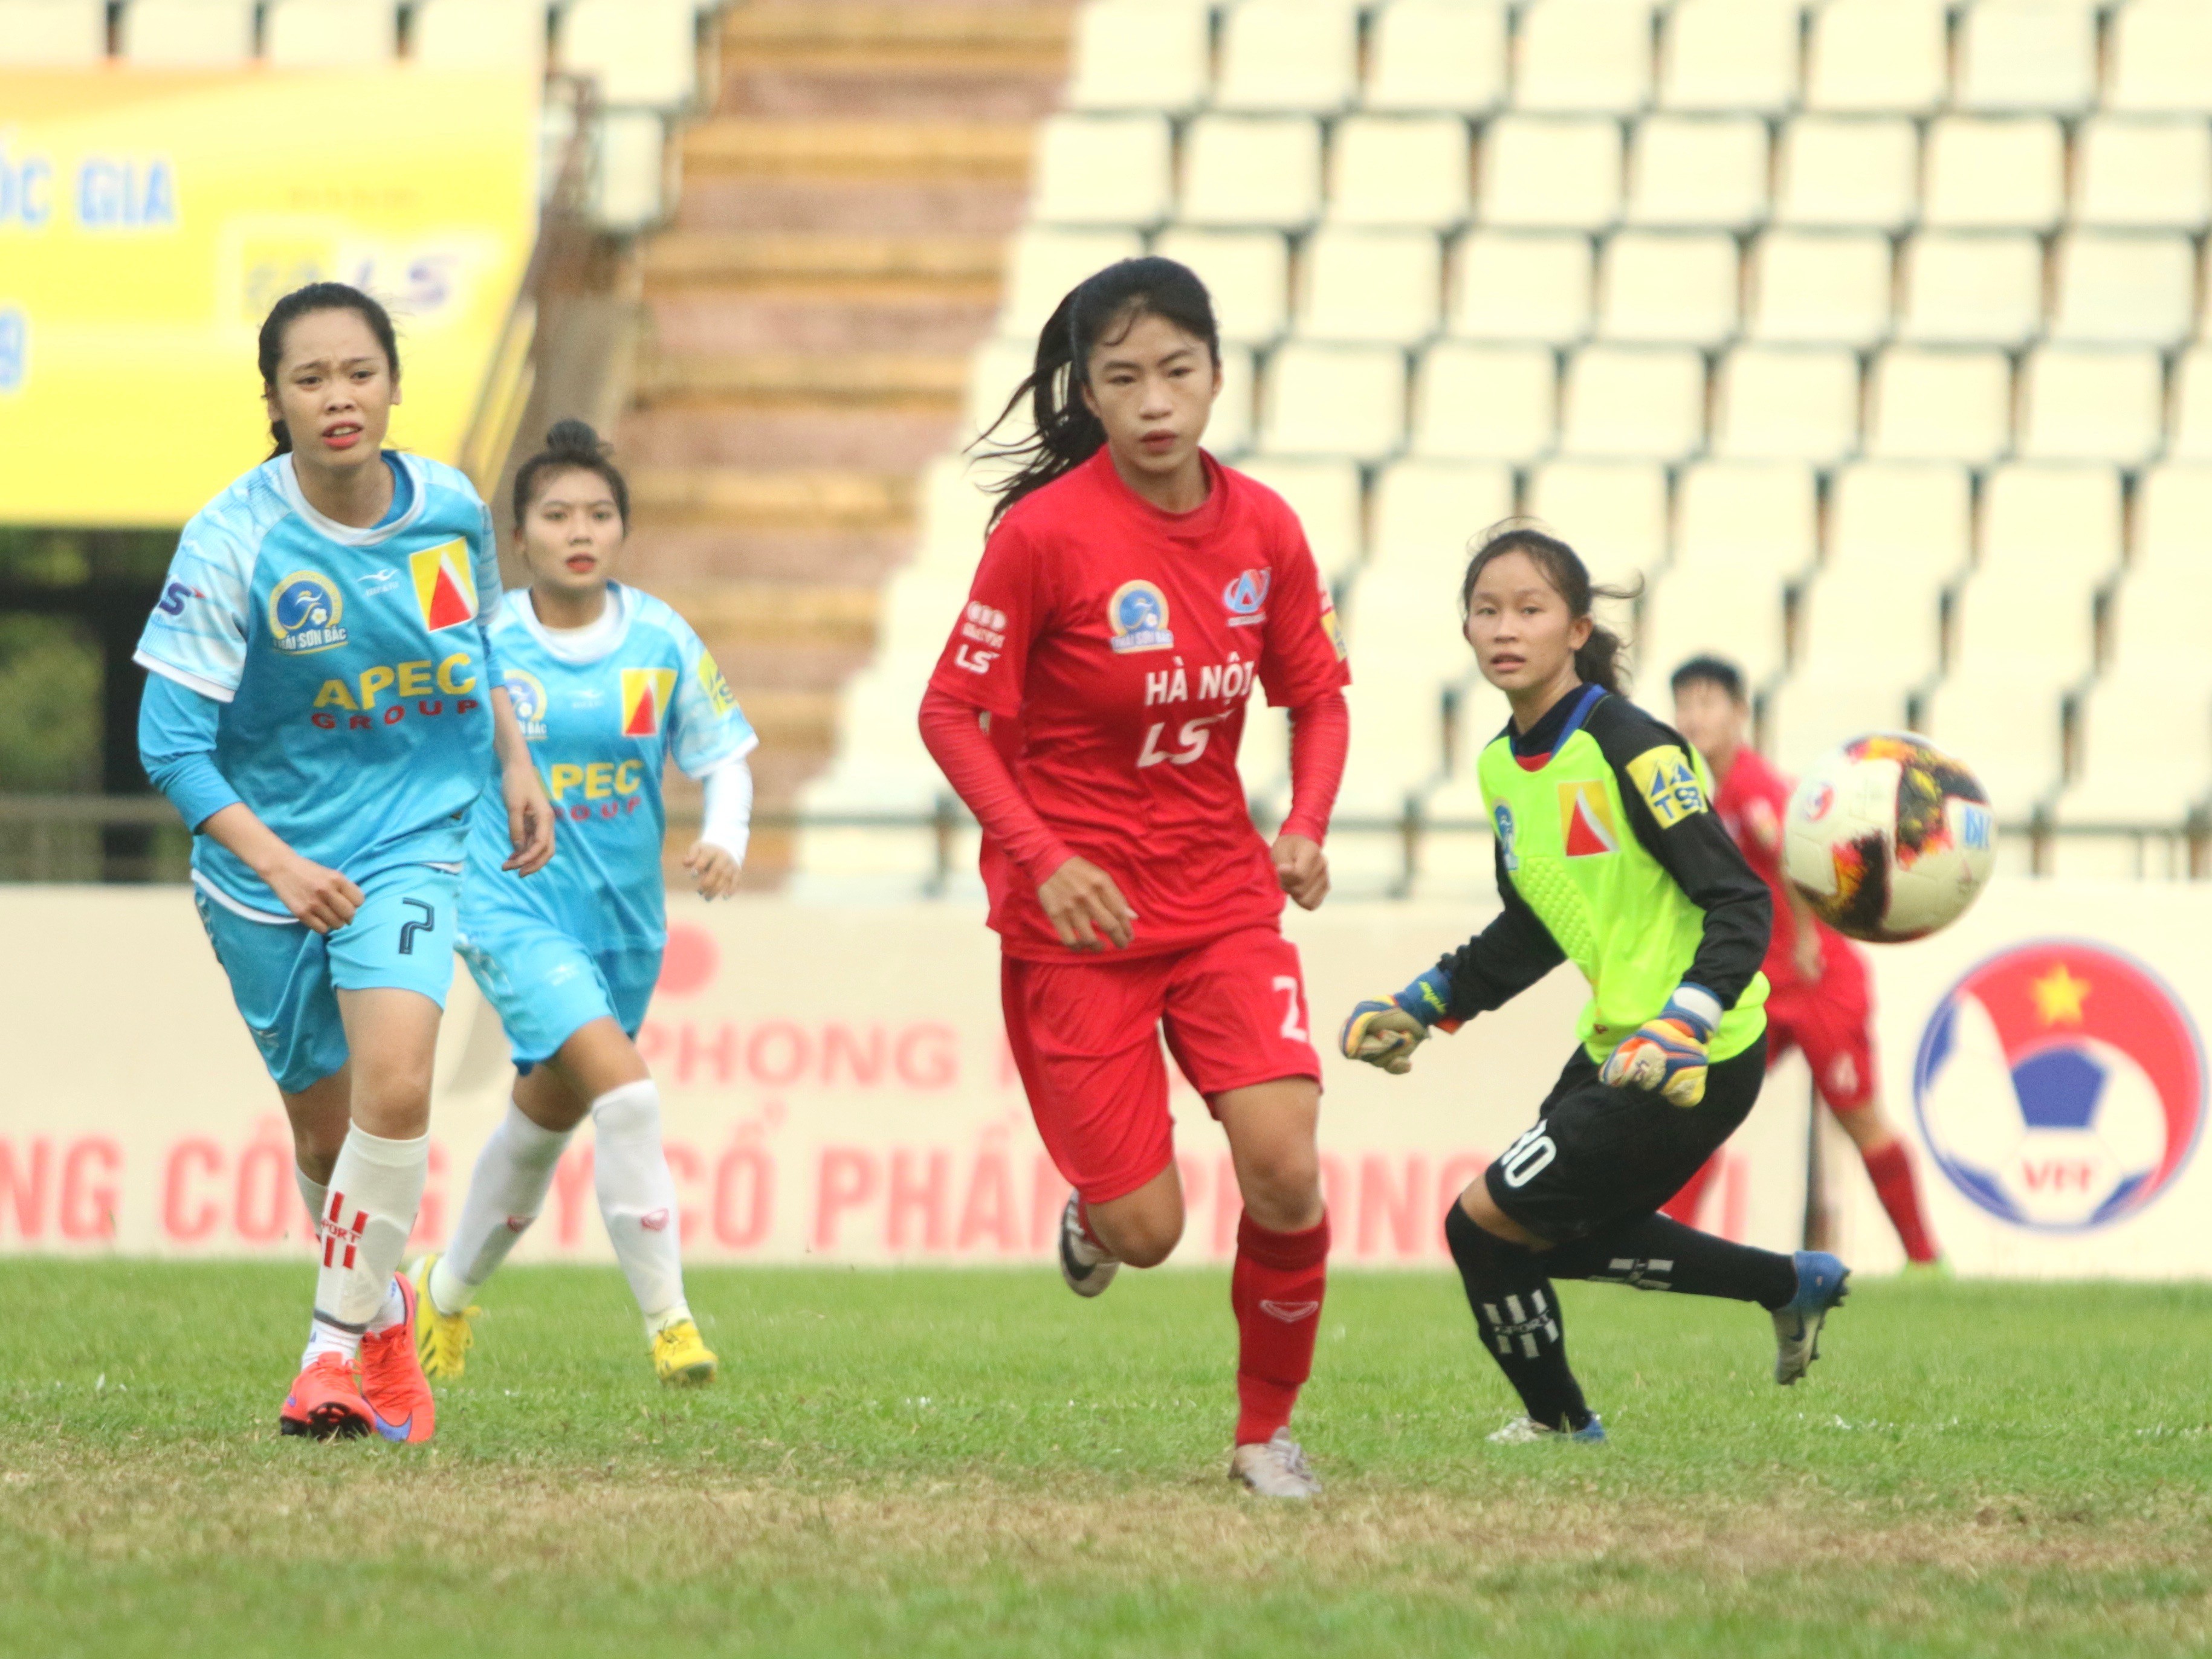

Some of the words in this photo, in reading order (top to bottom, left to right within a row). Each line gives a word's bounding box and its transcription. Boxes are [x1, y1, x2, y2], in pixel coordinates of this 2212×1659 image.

[79, 155, 176, 227] GIA
[314, 653, 476, 710] APEC
[955, 643, 1001, 674] LS
[1145, 655, 1188, 707] HÀ
[1198, 650, 1255, 707] NỘI
[311, 699, 478, 729] GROUP
[1136, 710, 1235, 768] LS
[535, 759, 642, 800] PEC
[554, 797, 641, 821] OUP
[399, 897, 435, 955] 7
[1272, 975, 1308, 1041] 2
[162, 1113, 450, 1243] CÔ
